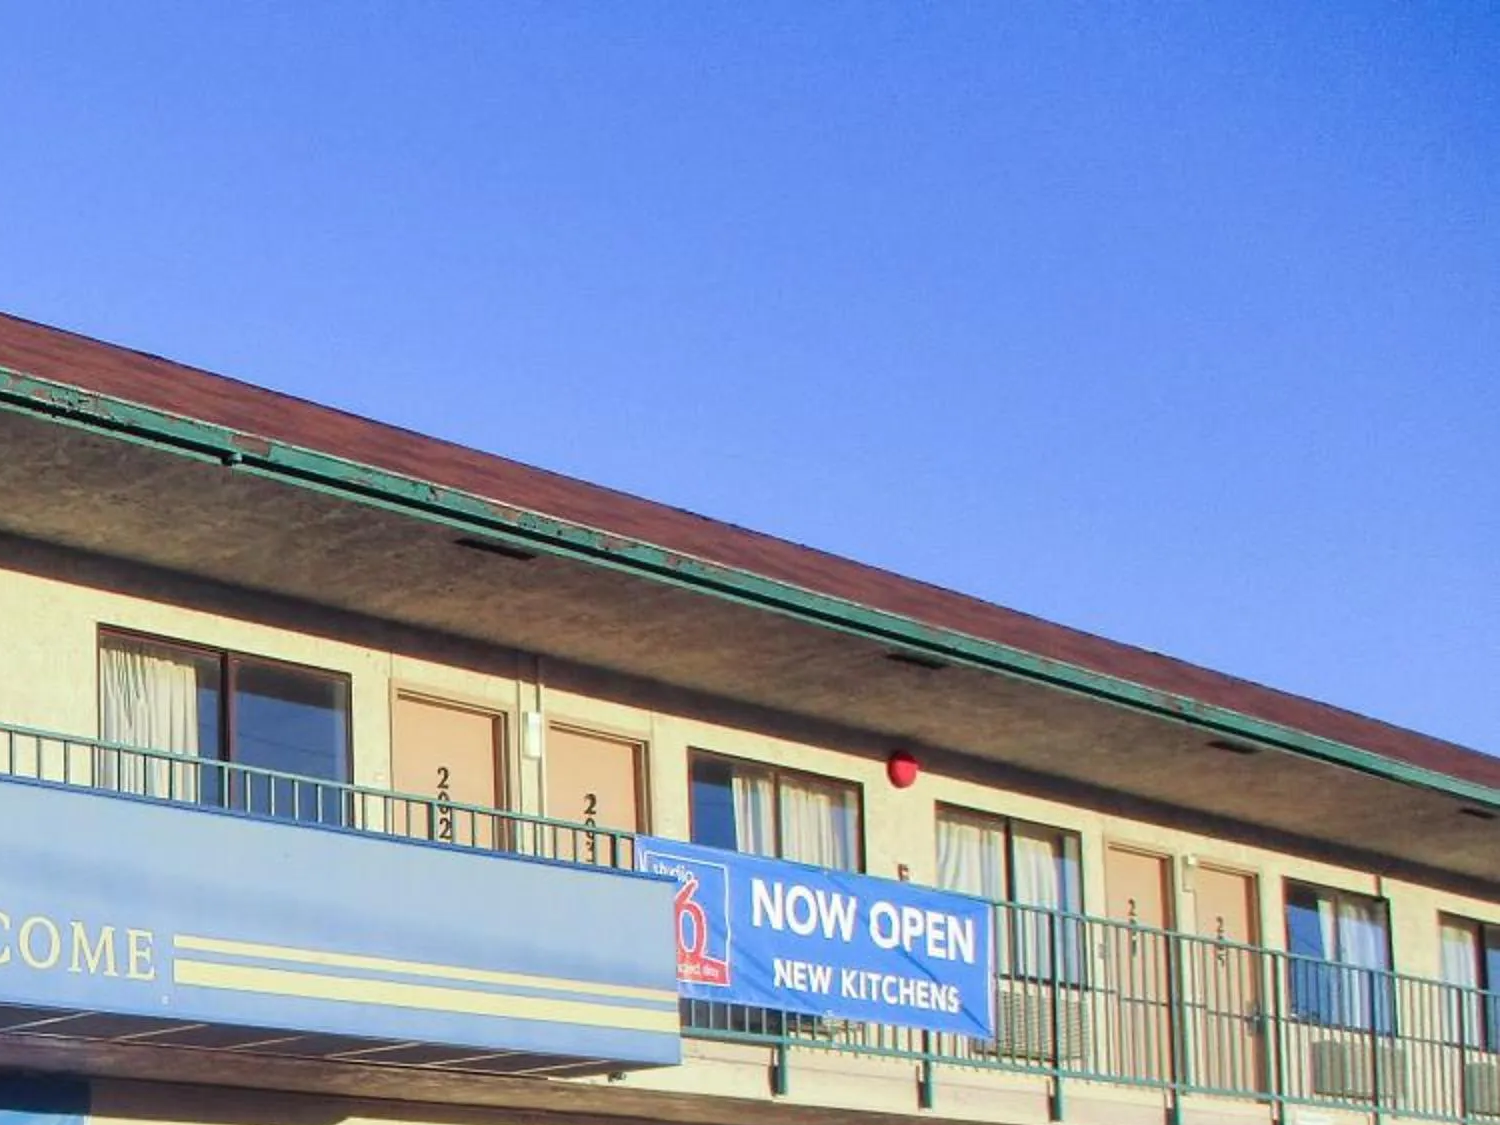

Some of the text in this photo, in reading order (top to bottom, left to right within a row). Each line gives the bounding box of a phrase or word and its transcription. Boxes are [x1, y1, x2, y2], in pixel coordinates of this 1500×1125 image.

[437, 766, 453, 840] 202
[675, 879, 707, 960] 6
[750, 877, 976, 965] NOW OPEN
[773, 957, 962, 1014] NEW KITCHENS
